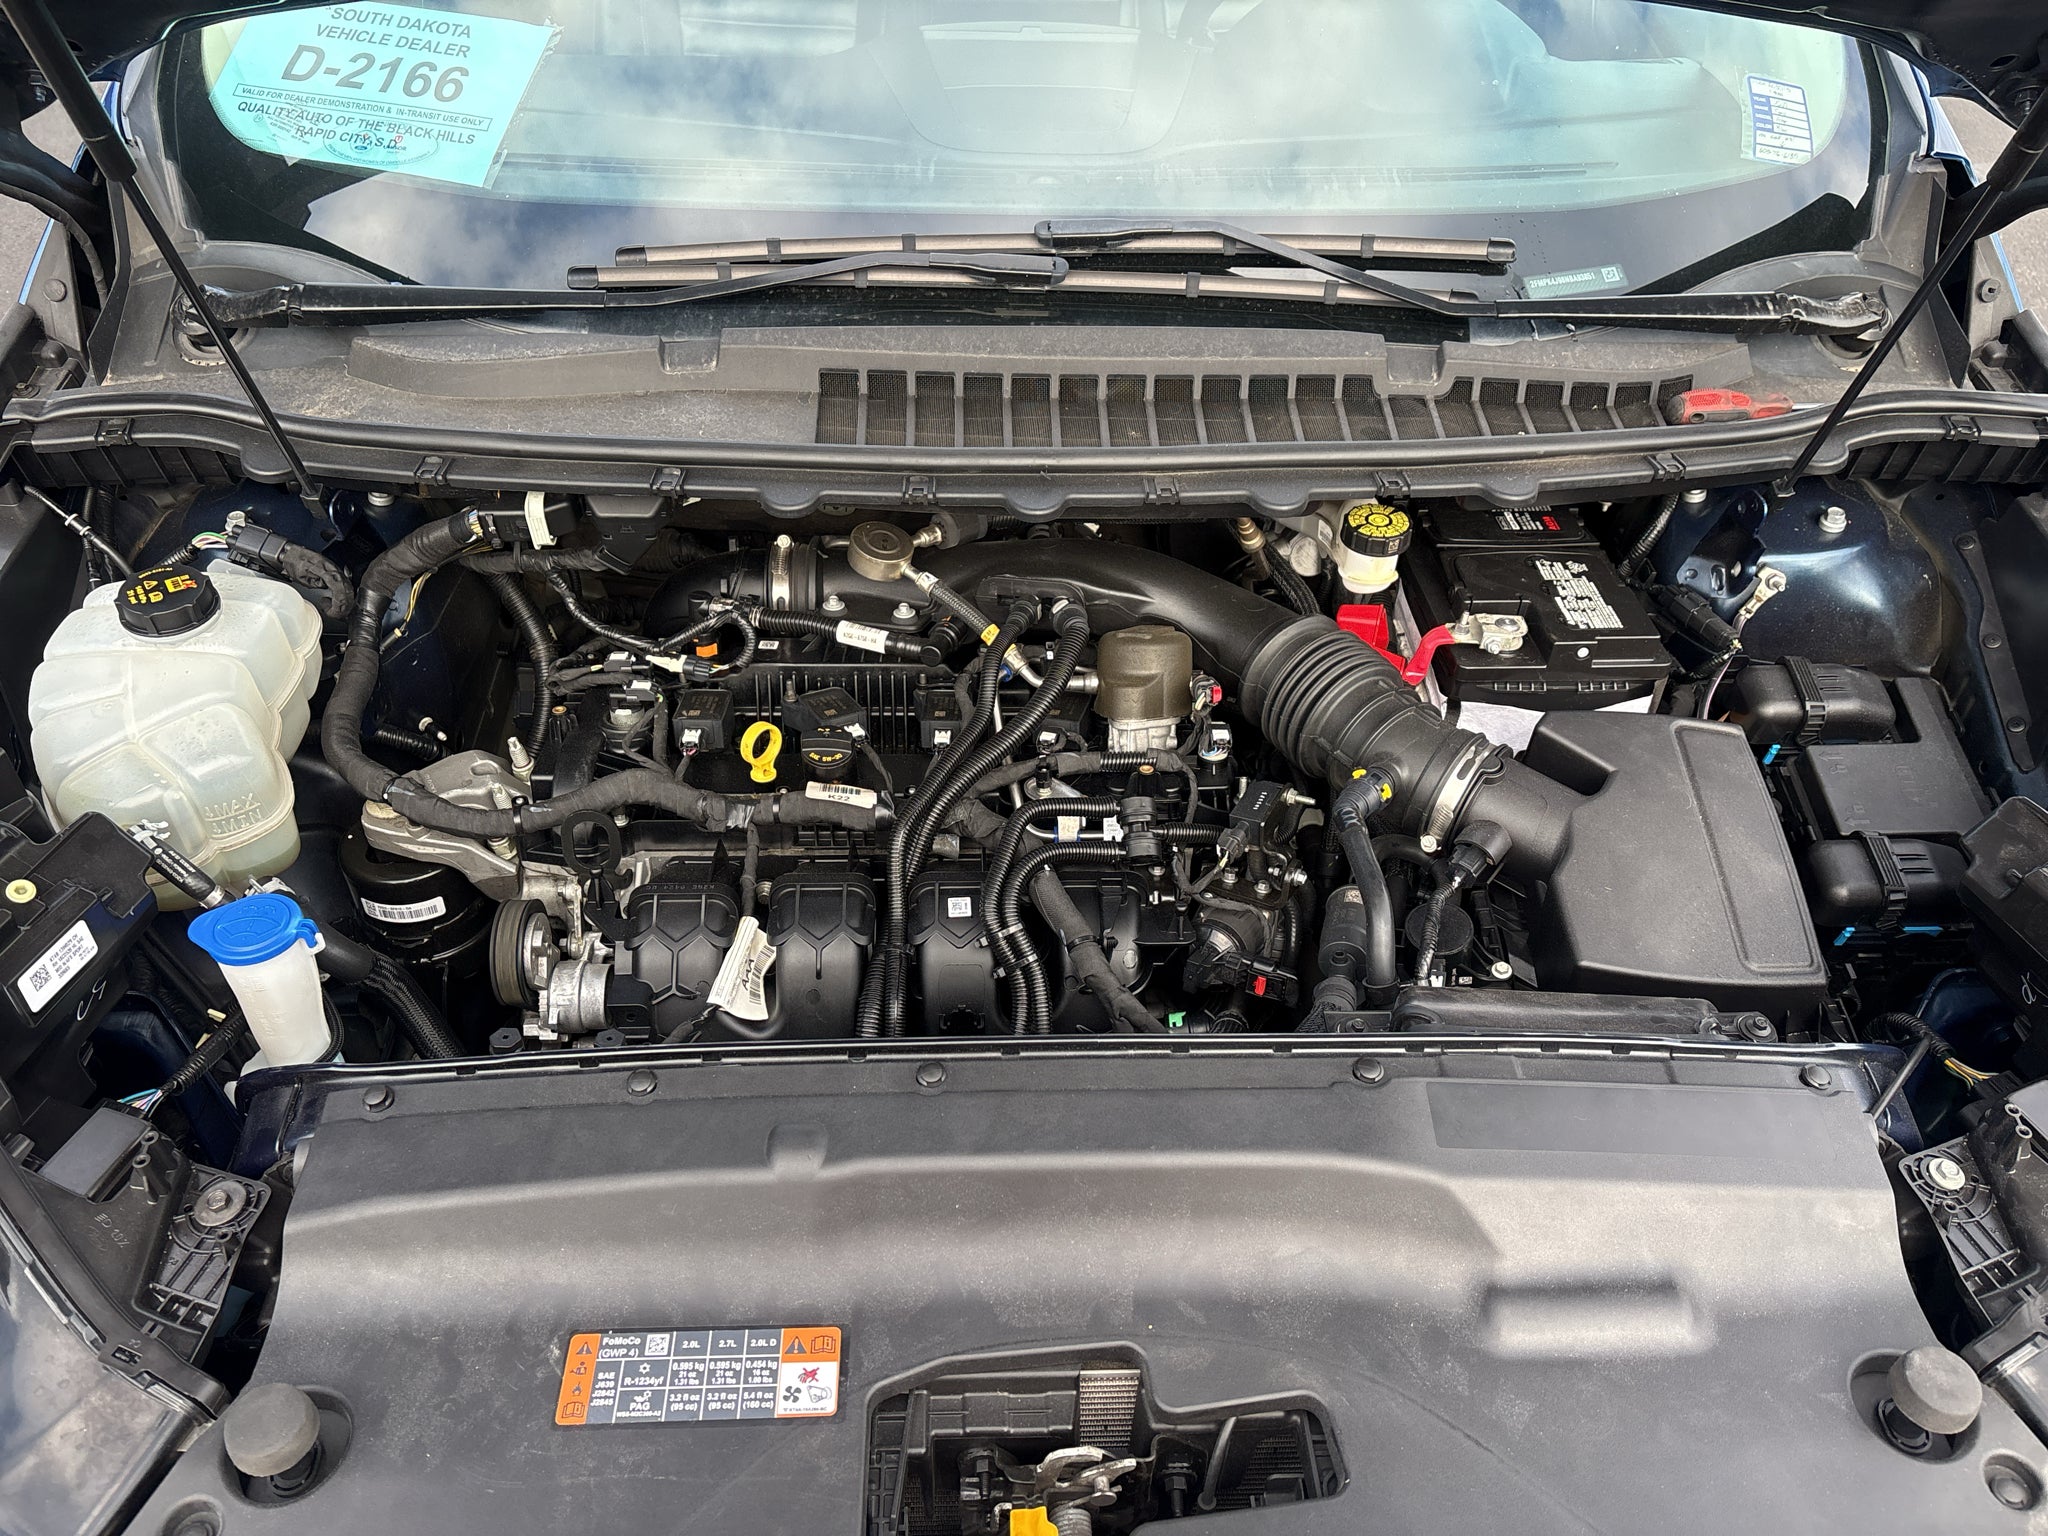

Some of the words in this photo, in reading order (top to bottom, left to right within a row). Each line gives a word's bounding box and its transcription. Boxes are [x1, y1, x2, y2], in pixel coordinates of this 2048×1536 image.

[331, 7, 394, 27] SOUTH
[396, 16, 471, 38] DAKOTA
[316, 24, 393, 46] VEHICLE
[395, 36, 471, 58] DEALER
[281, 44, 469, 103] D-2166
[242, 87, 265, 97] VALID
[266, 91, 284, 99] FOR
[284, 93, 316, 105] DEALER
[317, 97, 385, 113] DEMONSTRATION
[396, 108, 442, 120] IN-TRANSIT
[443, 114, 460, 123] USE
[460, 117, 485, 126] ONLY
[238, 101, 296, 118] QUALITY
[294, 110, 333, 124] AUTO
[335, 115, 356, 127] OF
[358, 118, 384, 132] THE
[386, 123, 434, 140] BLACK
[436, 130, 476, 145] HILLS
[295, 125, 337, 140] RAPID
[214, 792, 258, 817] MAX
[222, 809, 262, 833] MIN
[603, 1336, 641, 1346] FoMoCo
[682, 1340, 700, 1349] 2.0L
[718, 1339, 737, 1348] 2.7L
[750, 1339, 768, 1347] 2.0L
[770, 1338, 777, 1346] D
[598, 1348, 627, 1359] (GWP
[628, 1348, 639, 1358] 4)
[672, 1361, 694, 1371] 0.595
[695, 1361, 705, 1371] kg
[709, 1361, 731, 1370] 0.595
[731, 1361, 741, 1371] kg
[745, 1360, 767, 1369] 0.454
[768, 1360, 778, 1370] kg
[597, 1372, 616, 1380] SAE
[623, 1376, 664, 1387] R-1234yf
[669, 1393, 682, 1402] 3.2
[682, 1393, 689, 1401] fl
[706, 1393, 719, 1401] 3.2
[720, 1392, 727, 1400] fl
[743, 1392, 756, 1400] 5.4
[756, 1391, 763, 1399] fl
[629, 1402, 651, 1411] PAG
[670, 1402, 684, 1412] (95
[685, 1402, 697, 1411] cc)
[708, 1402, 721, 1411] (95
[722, 1401, 735, 1411] cc)
[761, 1400, 774, 1410] cc)
